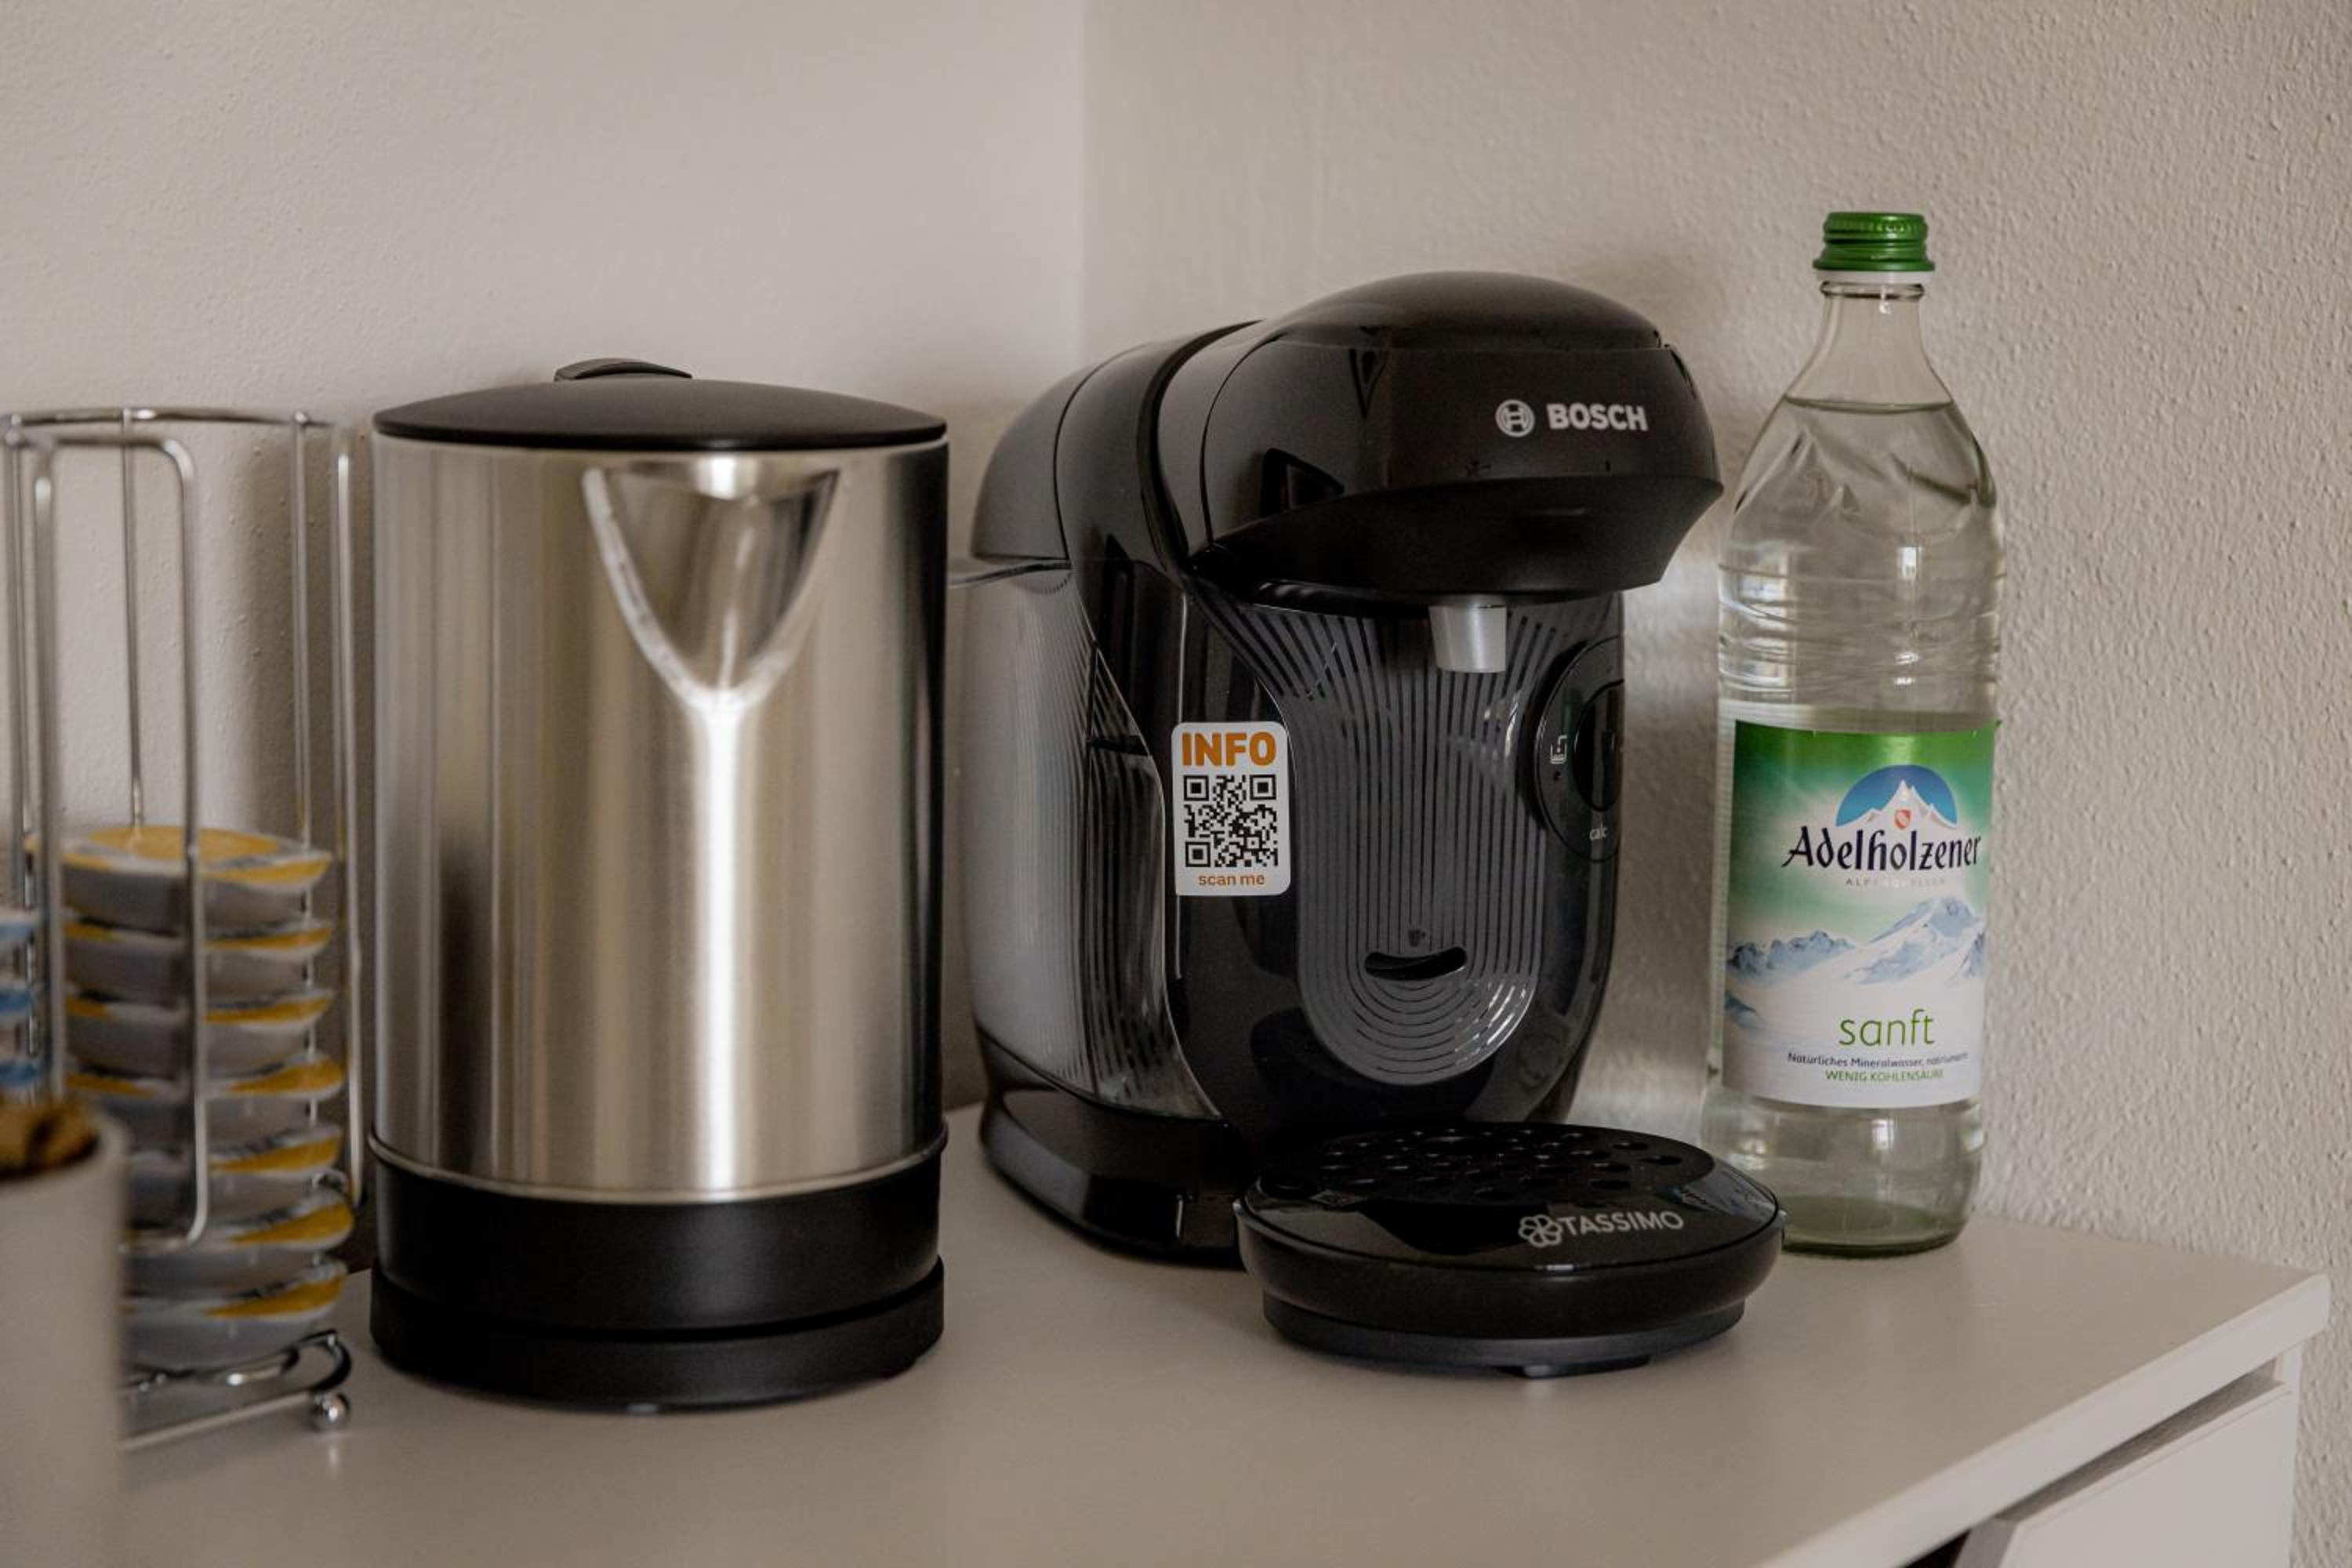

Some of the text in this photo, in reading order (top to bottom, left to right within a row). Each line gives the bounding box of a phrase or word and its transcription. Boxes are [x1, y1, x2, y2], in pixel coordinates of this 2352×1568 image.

[1545, 403, 1648, 431] BOSCH
[1181, 731, 1276, 767] INFO
[1781, 826, 1981, 871] Adelholzener
[1198, 873, 1265, 887] scan me
[1838, 1008, 1935, 1047] sanft
[1825, 1069, 1867, 1081] WENIG
[1558, 1211, 1684, 1236] TASSIMO
